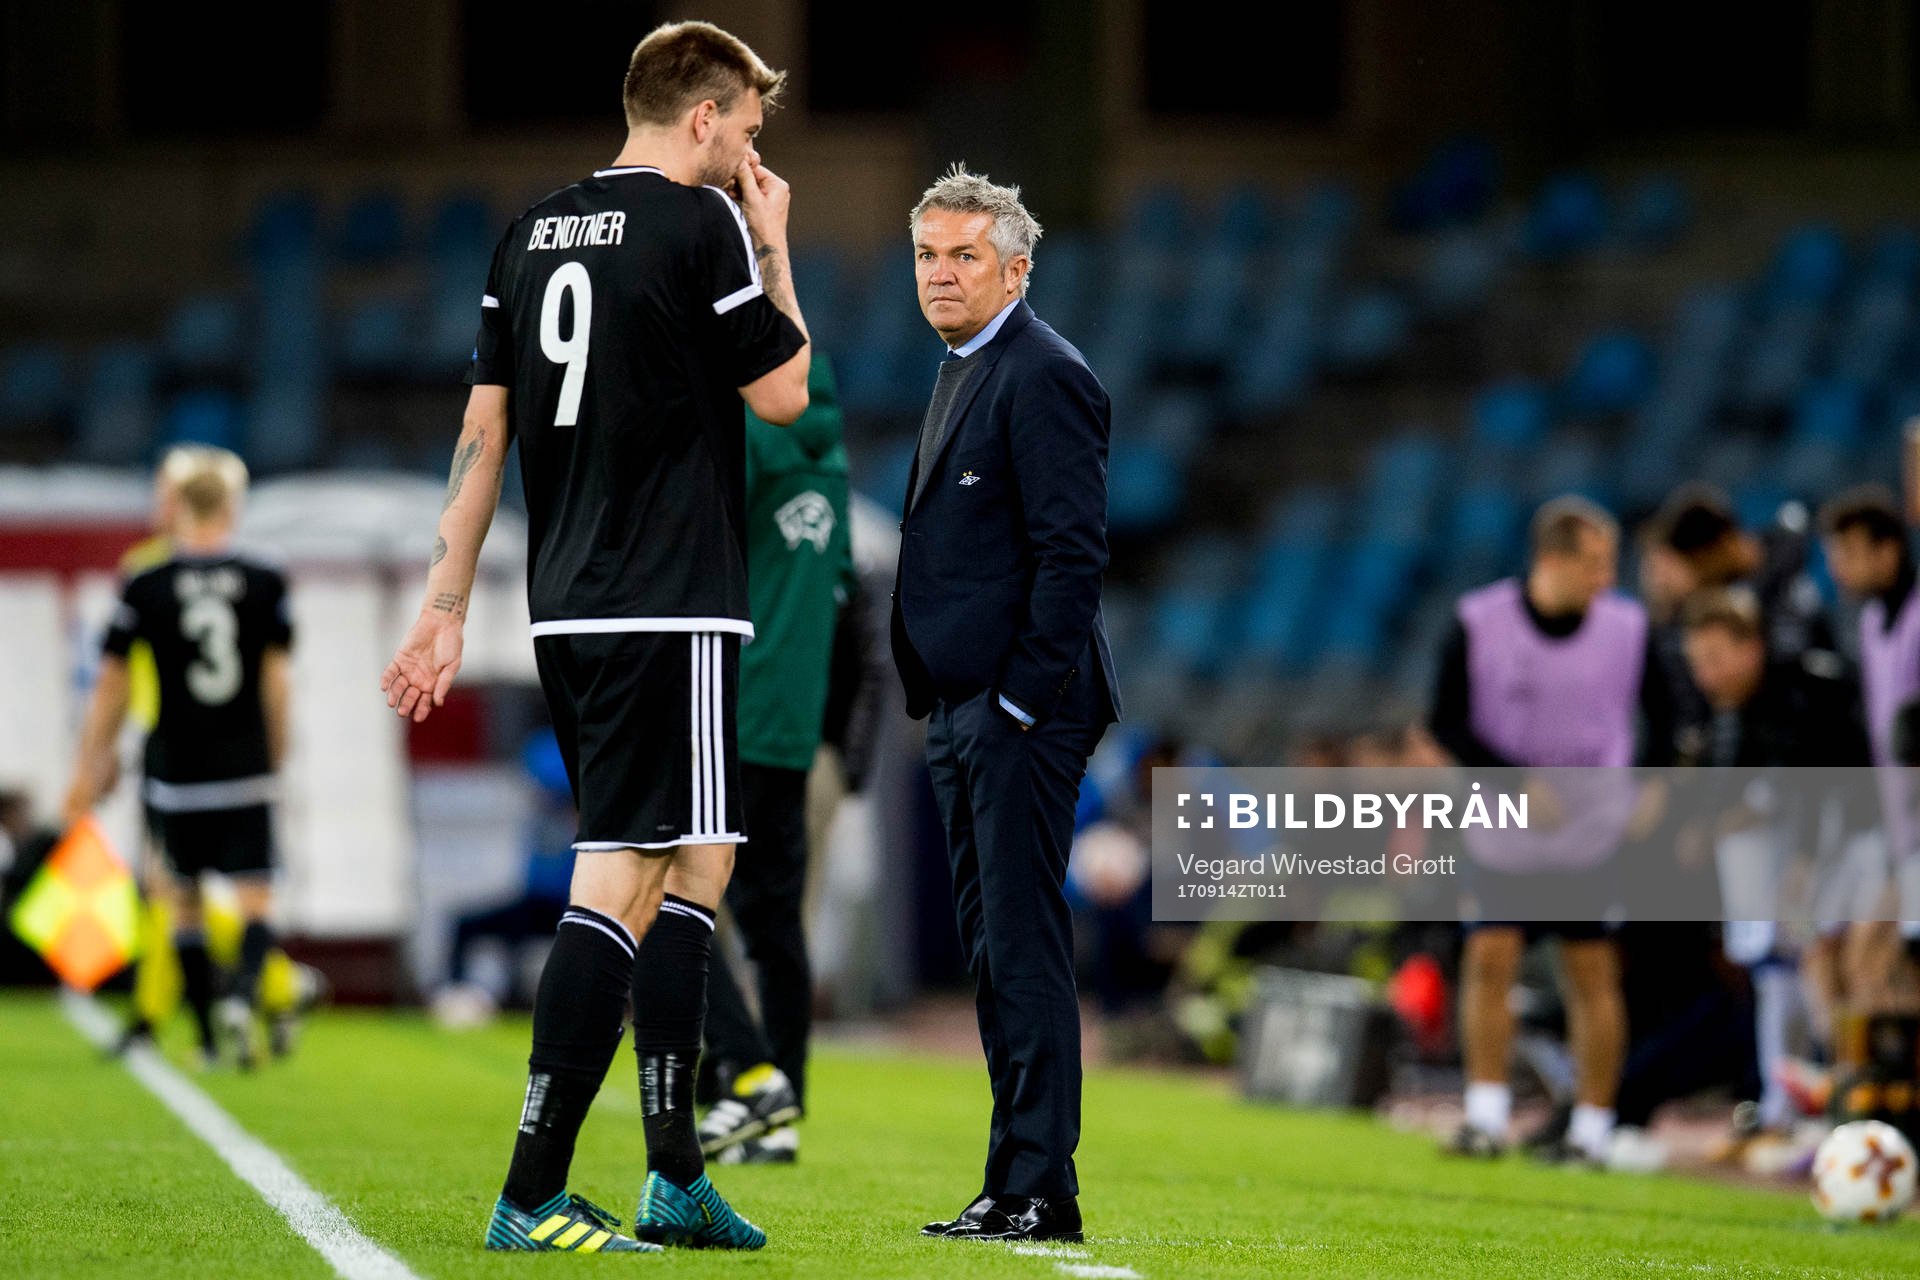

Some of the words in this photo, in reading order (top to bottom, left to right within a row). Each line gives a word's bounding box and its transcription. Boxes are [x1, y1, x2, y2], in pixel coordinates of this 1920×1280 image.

[528, 211, 626, 250] BENDTNER
[540, 261, 592, 426] 9
[180, 597, 242, 705] 3
